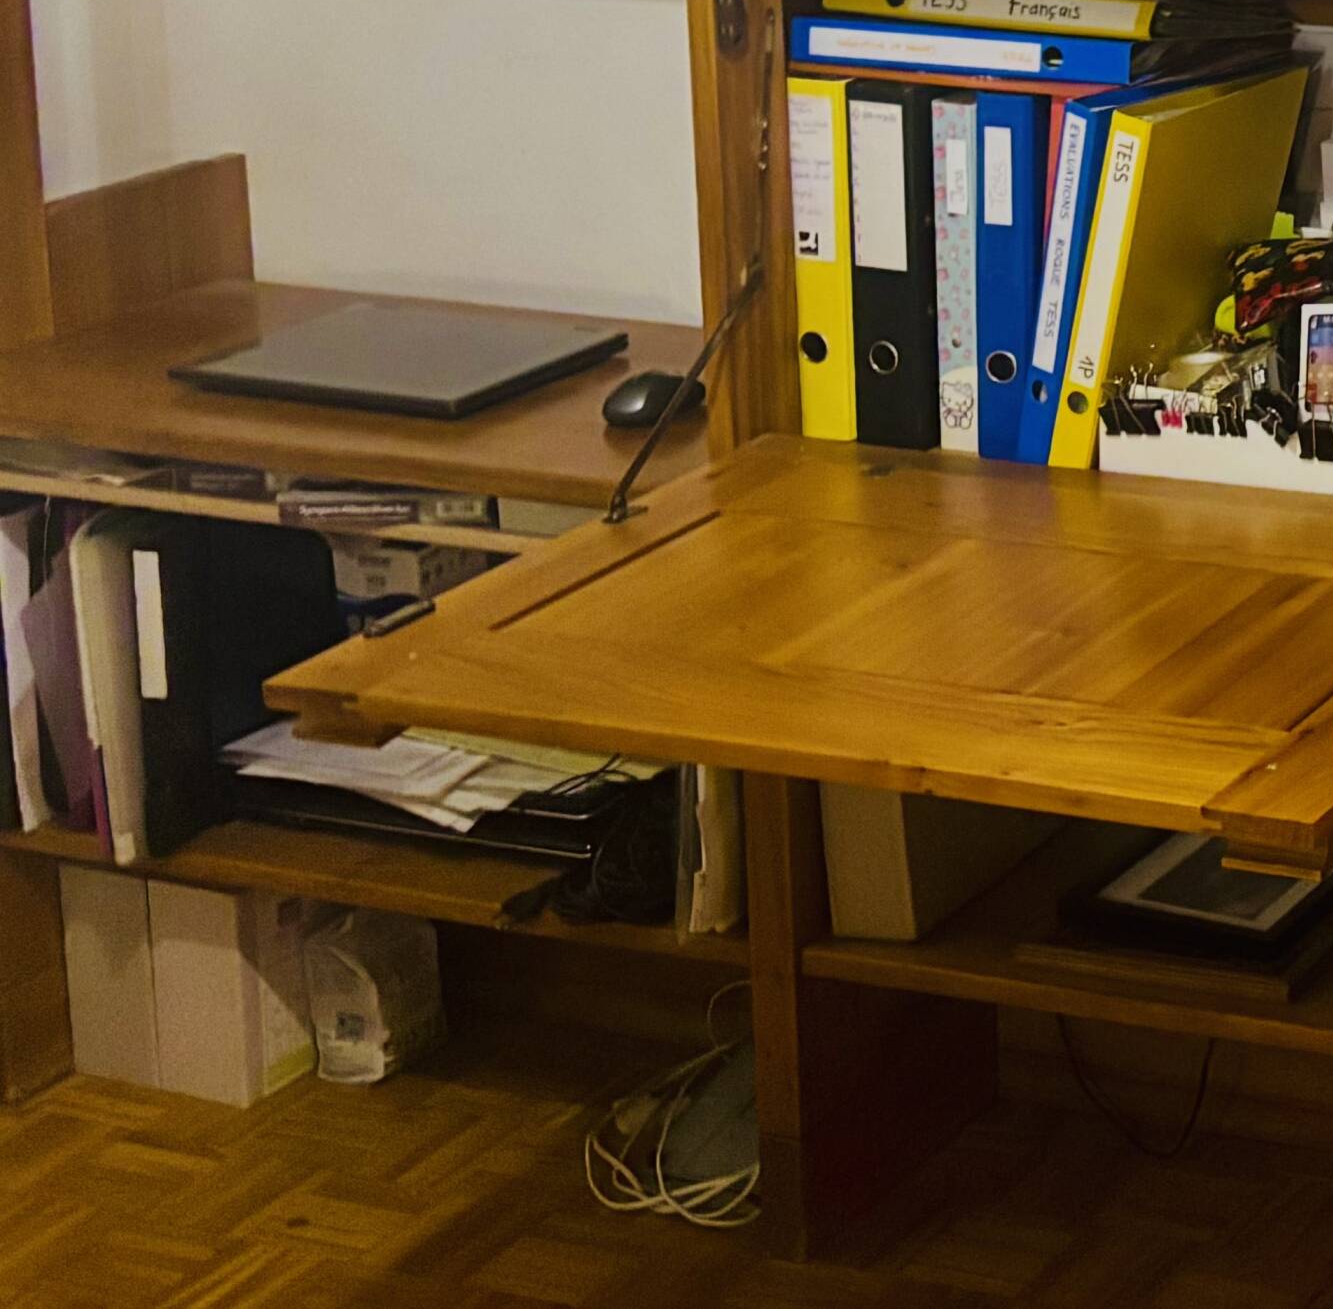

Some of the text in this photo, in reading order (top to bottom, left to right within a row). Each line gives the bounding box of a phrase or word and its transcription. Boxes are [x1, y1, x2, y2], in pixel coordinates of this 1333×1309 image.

[1113, 141, 1134, 183] TESS
[1043, 122, 1081, 338] EVALUATIONS ROQUE TESS
